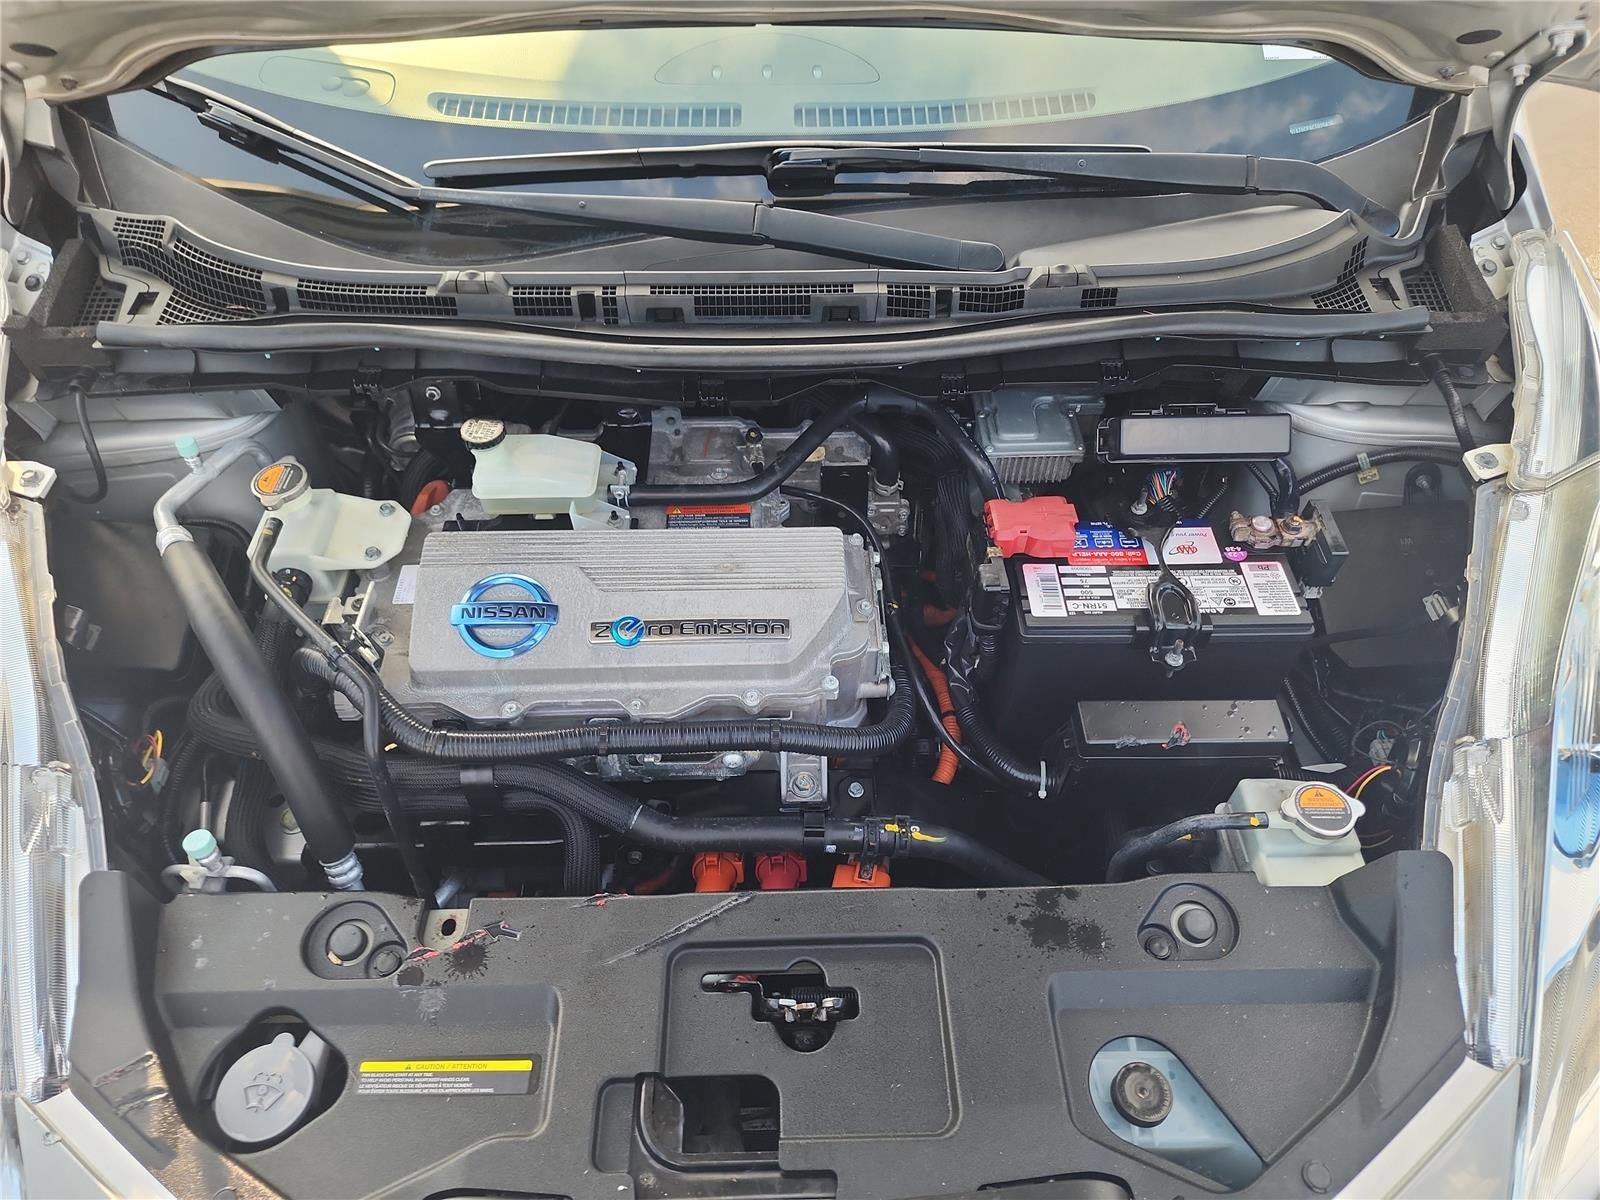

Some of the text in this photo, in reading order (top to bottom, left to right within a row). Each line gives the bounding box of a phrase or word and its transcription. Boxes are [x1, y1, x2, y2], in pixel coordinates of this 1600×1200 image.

[461, 606, 547, 619] NISSAN
[1072, 602, 1108, 610] 51RN-C
[679, 620, 785, 635] Emission
